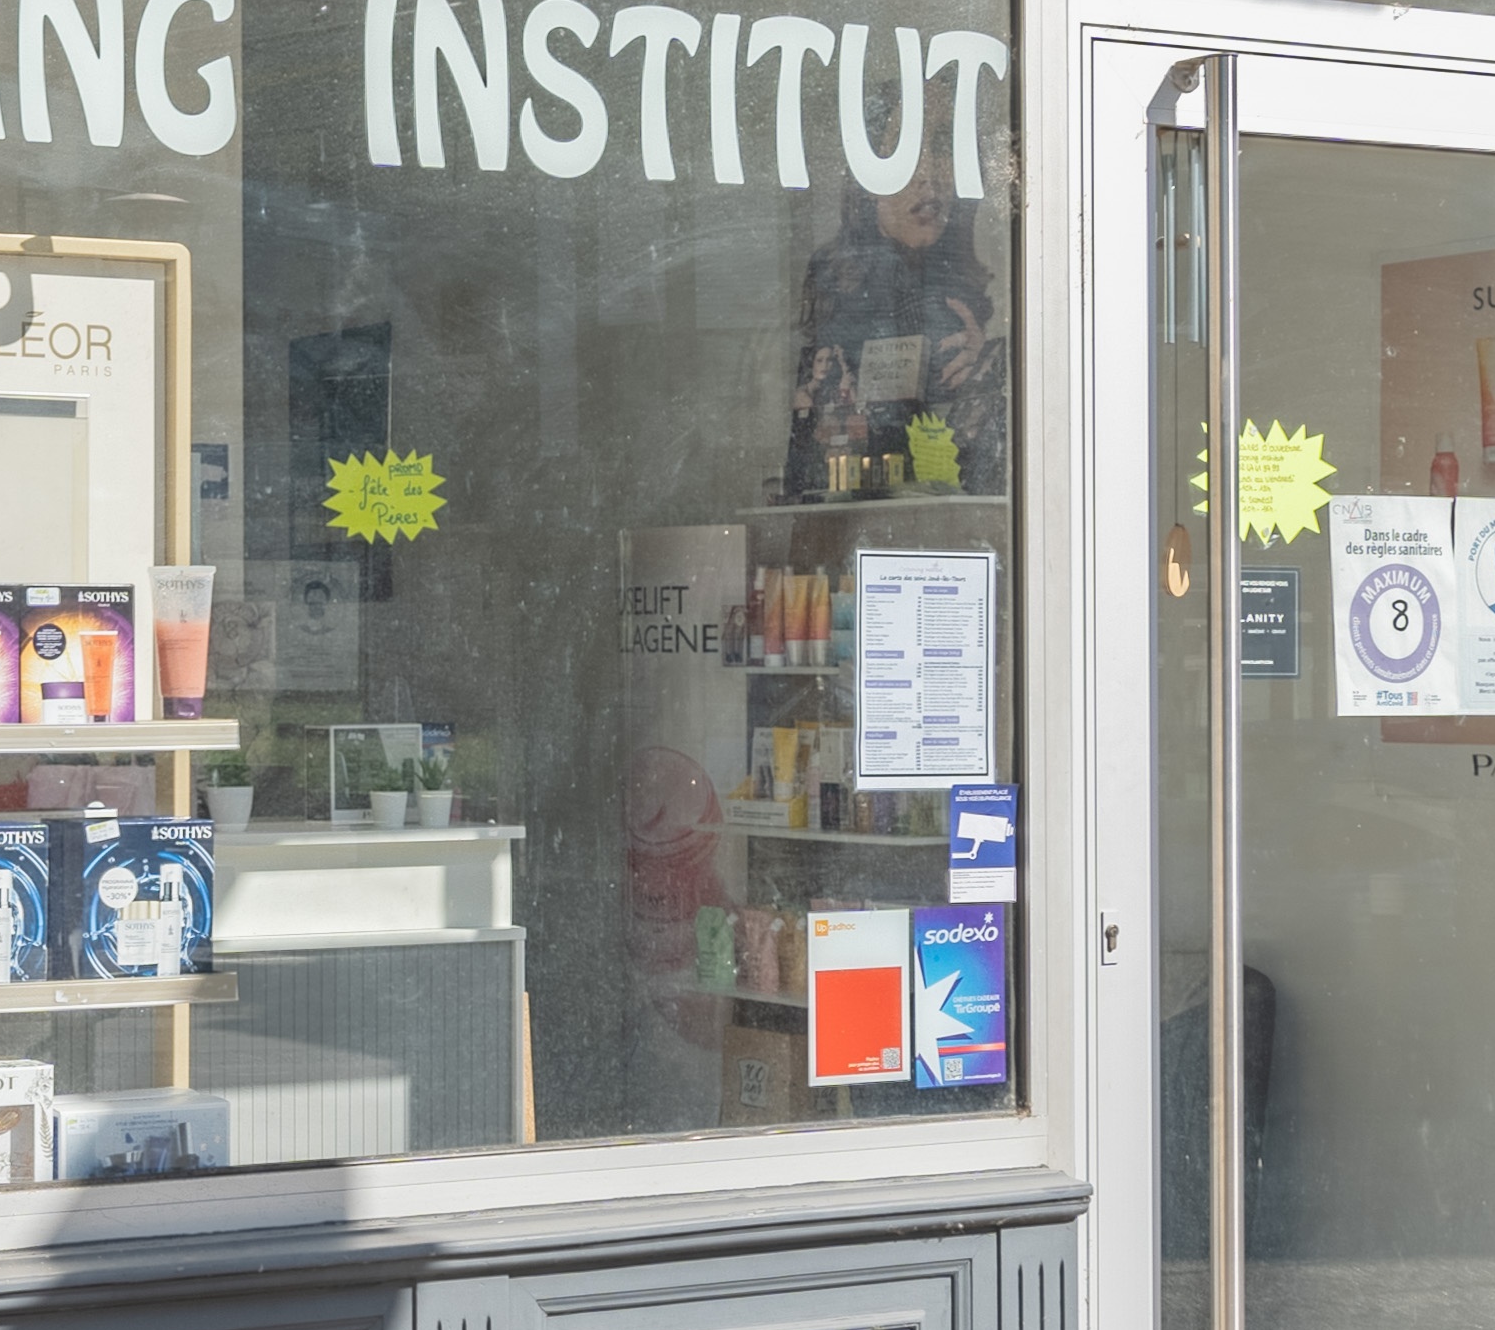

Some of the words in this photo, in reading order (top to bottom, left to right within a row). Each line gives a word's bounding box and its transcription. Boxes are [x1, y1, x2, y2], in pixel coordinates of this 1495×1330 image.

[54, 364, 113, 377] PARIS
[404, 480, 423, 496] des
[1364, 528, 1389, 541] Dans
[1392, 528, 1400, 541] le
[1402, 529, 1428, 542] cadre
[1345, 542, 1363, 554] des
[1366, 542, 1396, 558] règles
[1398, 543, 1443, 556] sanitaires
[1468, 537, 1482, 561] PORT
[1480, 525, 1491, 538] DU
[158, 580, 206, 589] SOTHYS
[1360, 570, 1431, 604] MAXIMUM
[83, 590, 129, 602] SOTHYS
[1392, 599, 1409, 631] 8
[1376, 691, 1403, 699] #Tous
[158, 826, 212, 839] SOTHYS
[828, 923, 856, 931] cadhoc
[923, 922, 999, 945] sodexo
